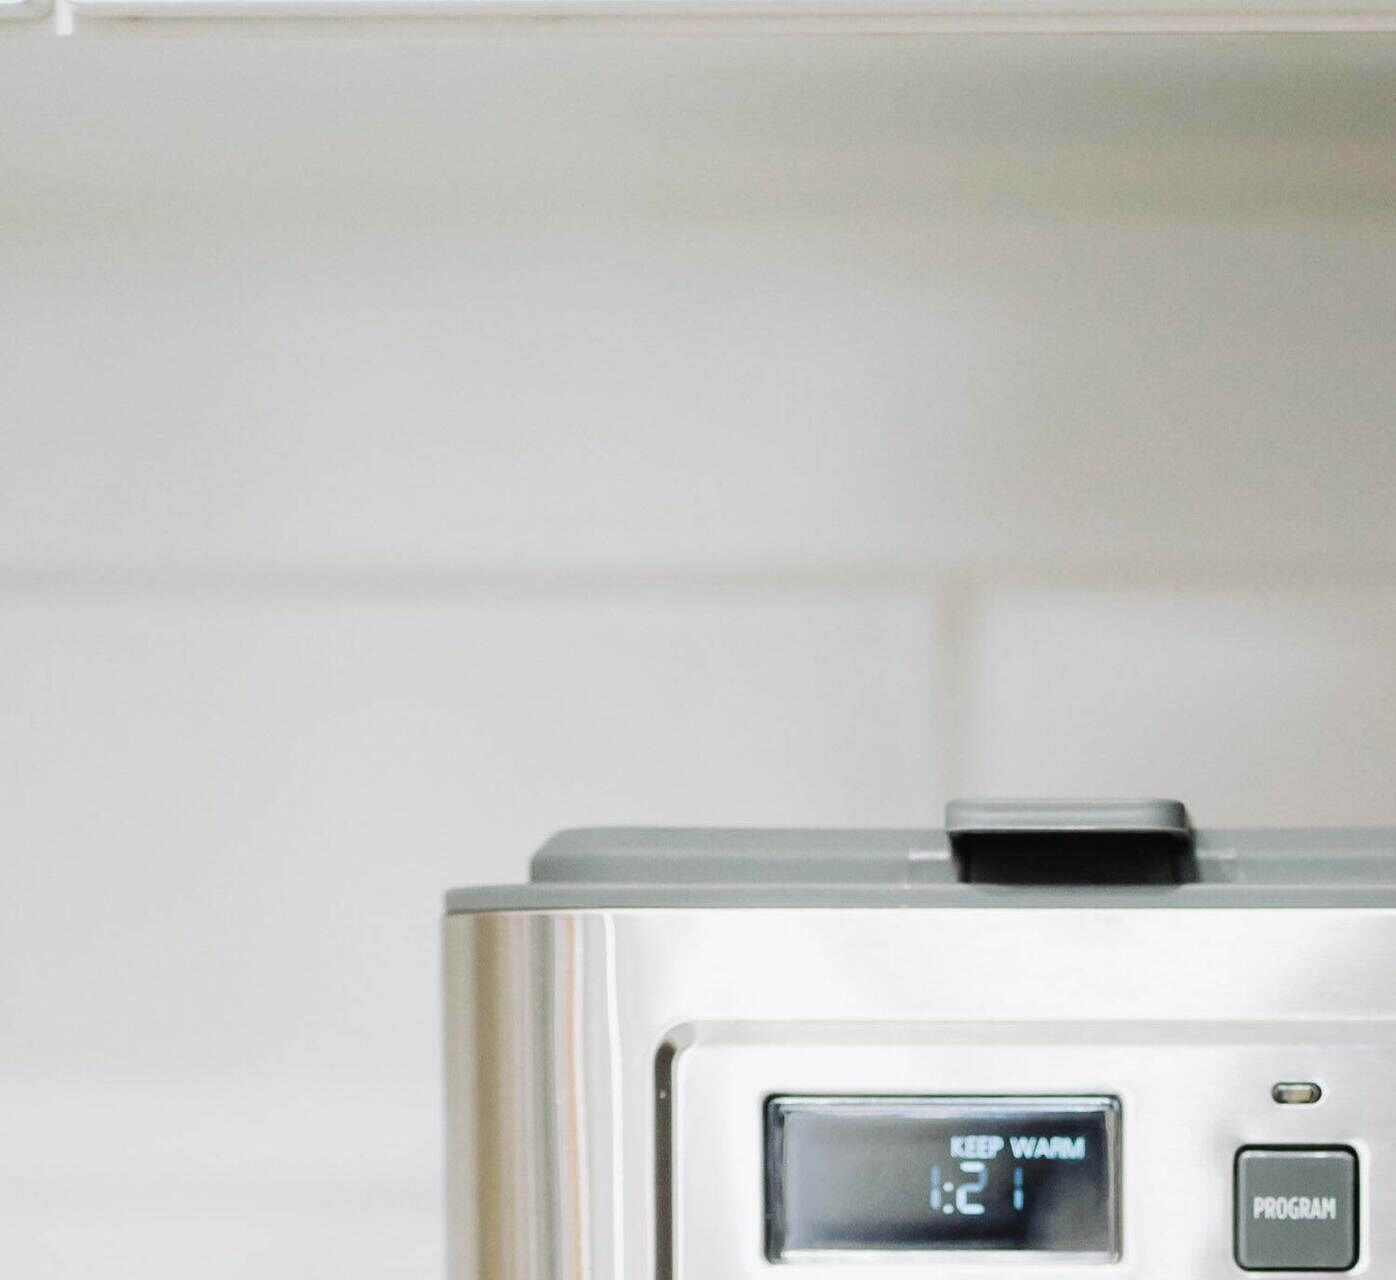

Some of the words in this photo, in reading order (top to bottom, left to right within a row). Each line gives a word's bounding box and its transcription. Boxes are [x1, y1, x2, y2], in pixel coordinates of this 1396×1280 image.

[950, 1135, 1004, 1159] KEEP
[1009, 1136, 1086, 1159] WARM
[930, 1161, 1024, 1215] 1:21
[1253, 1197, 1336, 1219] PROGRAM
